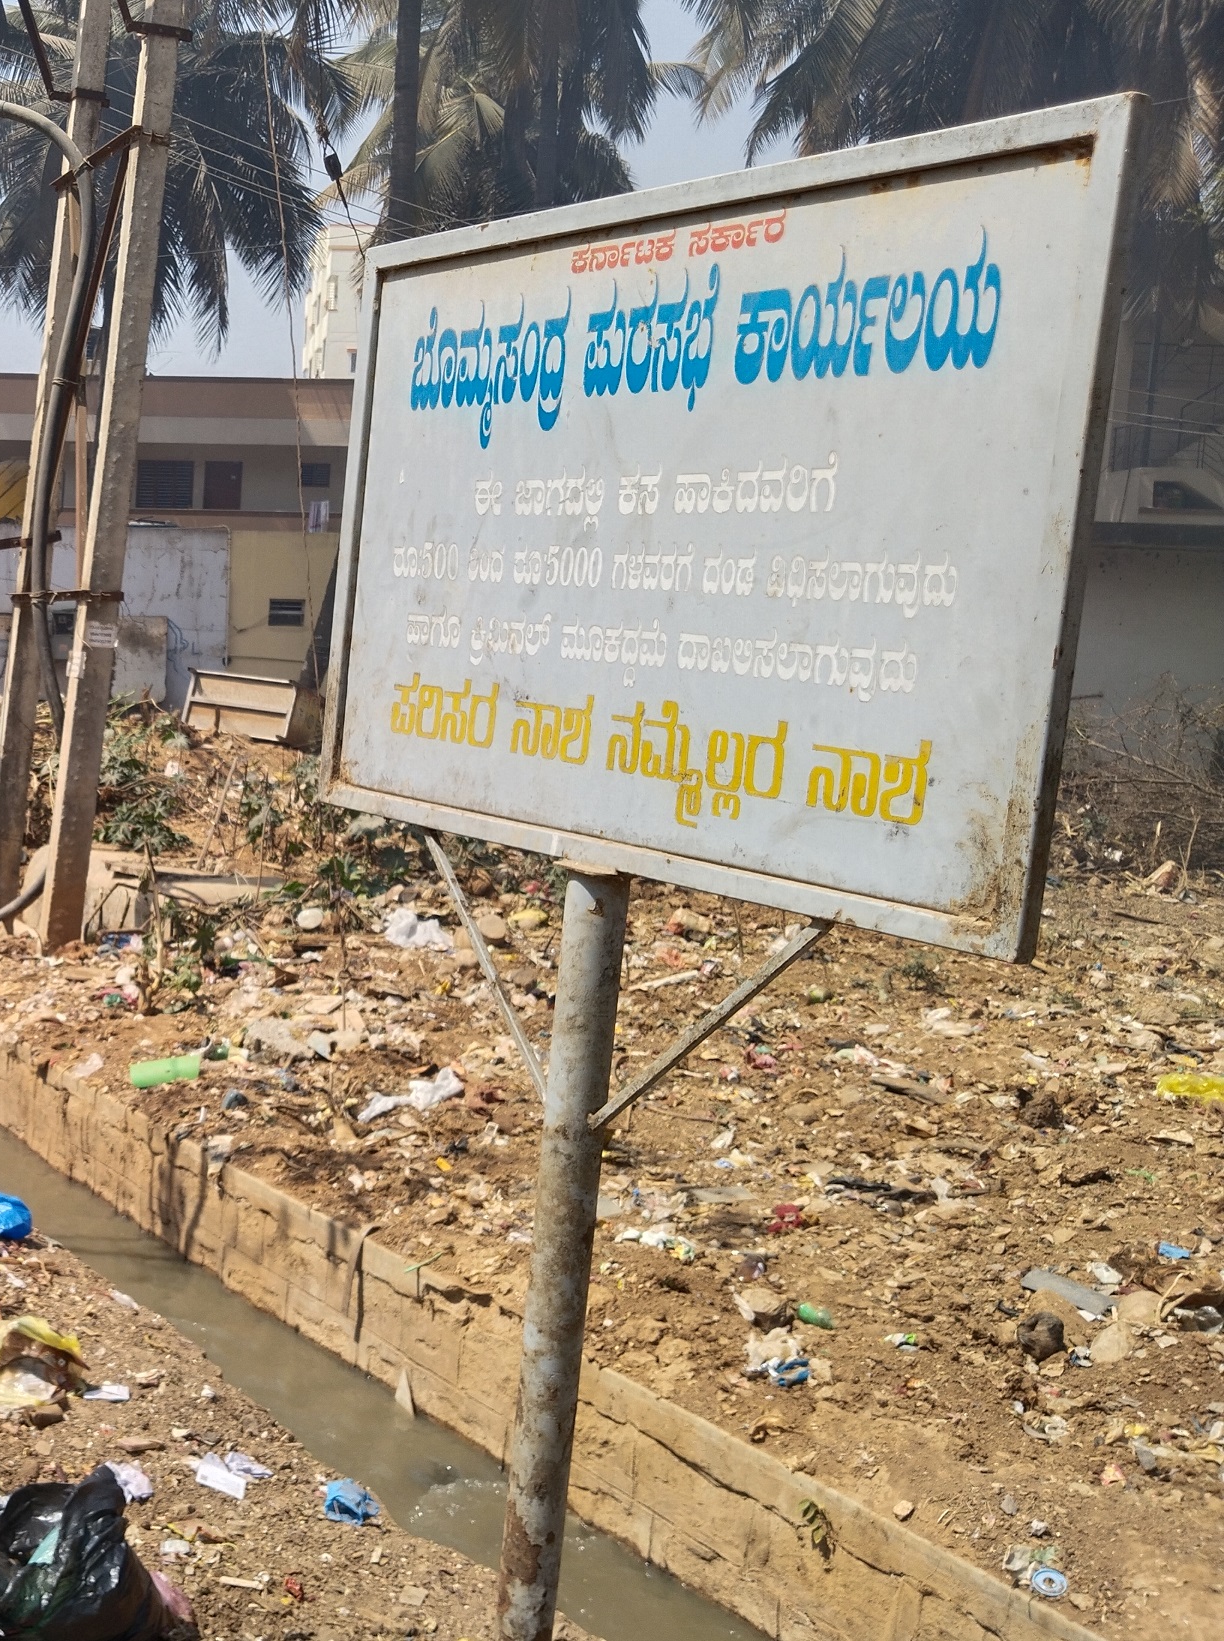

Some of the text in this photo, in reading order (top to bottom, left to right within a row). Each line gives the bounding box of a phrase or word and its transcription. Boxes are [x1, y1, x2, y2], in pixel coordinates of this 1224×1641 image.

[570, 207, 786, 274] ಕರ್ನಾಟಕ ಸರ್ಕಾರ
[410, 225, 1001, 449] ಬೊಮ್ಮಸಂದ್ರ ಪುರಸಭೆ ಕಾರ್ಯಲಯ
[475, 451, 839, 532] ಈ ಜಾಗದಲ್ಲಿ ಕಸ ಹಾಕಿದವರಿಗೆ
[703, 544, 757, 596] ದಂಡ
[406, 605, 461, 649] ಹಾಗೂ
[469, 612, 552, 666] ಕ್ರಿಮಿನಲ್
[677, 629, 917, 702] ದಾಖಲಿಸಲಾಗುವುದು
[390, 672, 500, 749] ಪರಿಸರ
[510, 694, 595, 766] ನಾಶ
[806, 739, 932, 826] ನಾಶ
